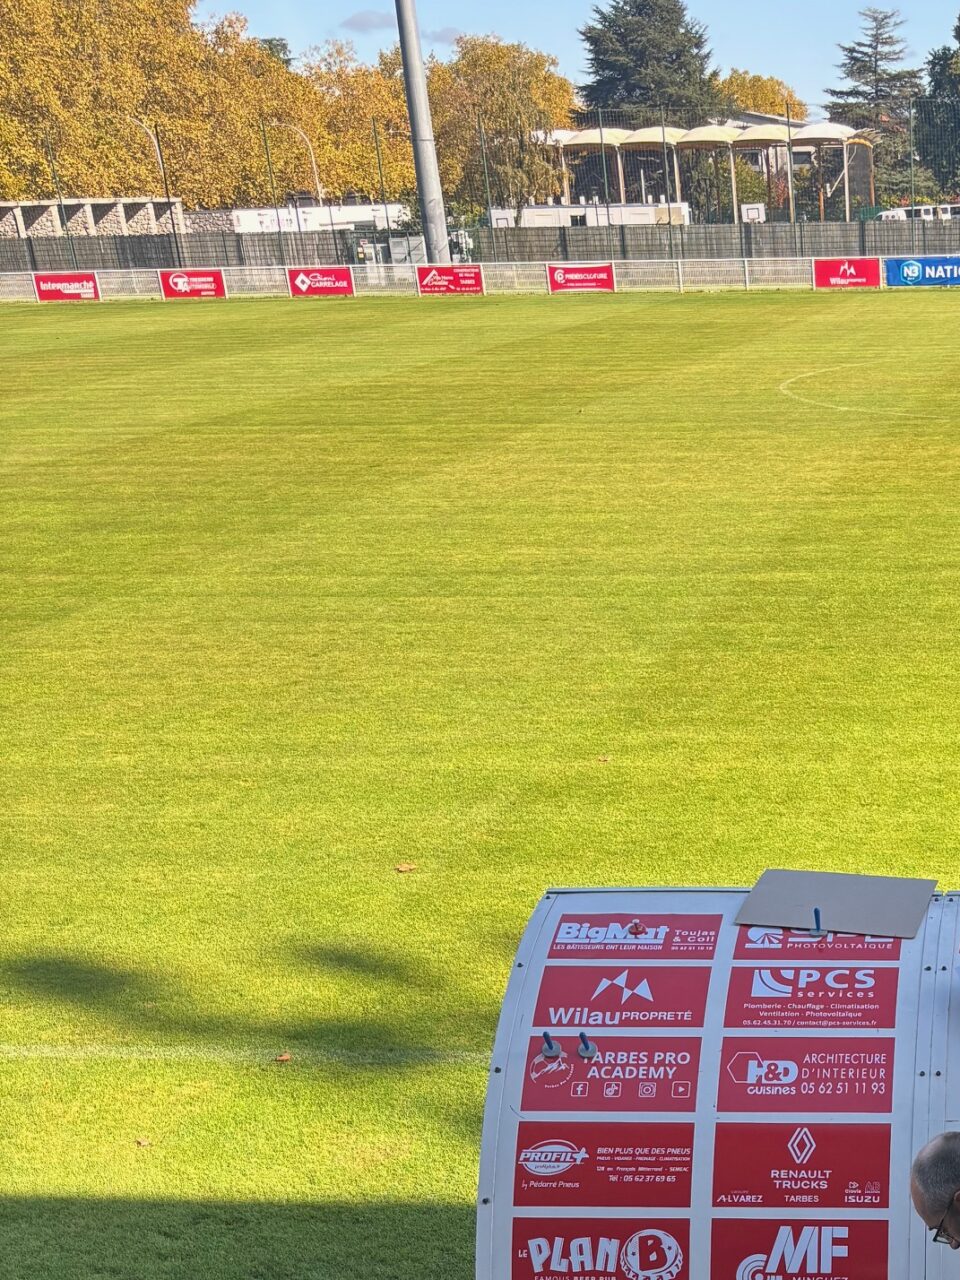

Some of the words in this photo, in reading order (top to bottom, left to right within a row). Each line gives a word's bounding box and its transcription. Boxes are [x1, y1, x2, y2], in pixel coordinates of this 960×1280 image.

[904, 267, 919, 277] N3
[674, 929, 715, 937] Toujas
[797, 969, 876, 989] PCS
[797, 989, 875, 998] services
[787, 1003, 825, 1011] Chauffage
[548, 1007, 621, 1025] Wilau
[621, 1009, 693, 1021] PROPRETÉ
[653, 1051, 691, 1065] PRO
[803, 1053, 887, 1064] ARCHITECTURE
[587, 1066, 677, 1079] ACADEMY
[747, 1059, 799, 1084] H&D
[801, 1068, 886, 1079] D'INTERIEUR
[800, 1082, 815, 1094] 05
[818, 1082, 833, 1094] 62
[835, 1082, 849, 1094] 51
[855, 1082, 867, 1094] 11
[871, 1082, 885, 1094] 93
[770, 1169, 833, 1179] RENAULT
[529, 1180, 557, 1188] Pédarré
[773, 1180, 829, 1189] TRUCKS
[784, 1195, 820, 1203] TARBES
[518, 1249, 528, 1258] LE
[527, 1236, 621, 1273] PLAN
[638, 1234, 668, 1272] B
[765, 1225, 849, 1274] MF
